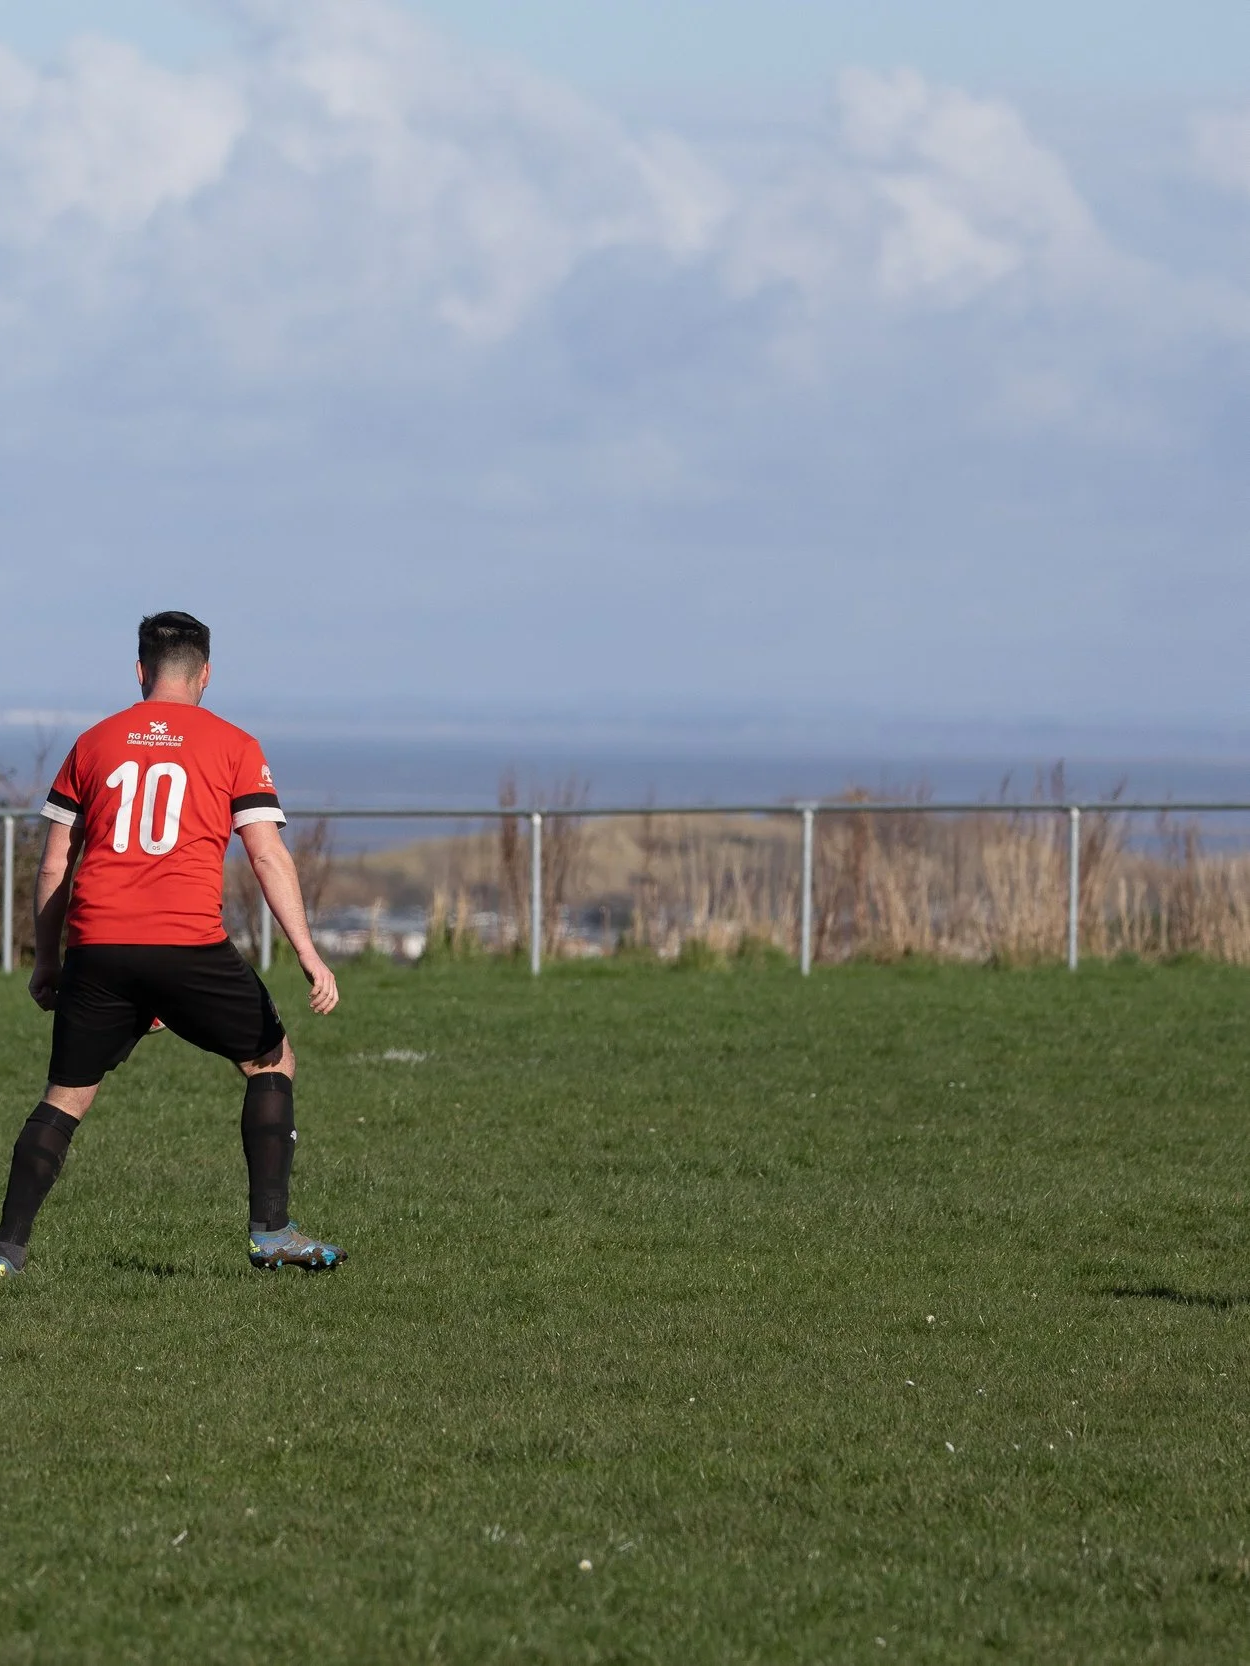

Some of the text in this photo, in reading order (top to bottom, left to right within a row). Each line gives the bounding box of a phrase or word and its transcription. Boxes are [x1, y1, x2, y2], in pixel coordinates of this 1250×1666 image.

[128, 732, 184, 742] RG HOWELLS
[106, 760, 187, 856] 10
